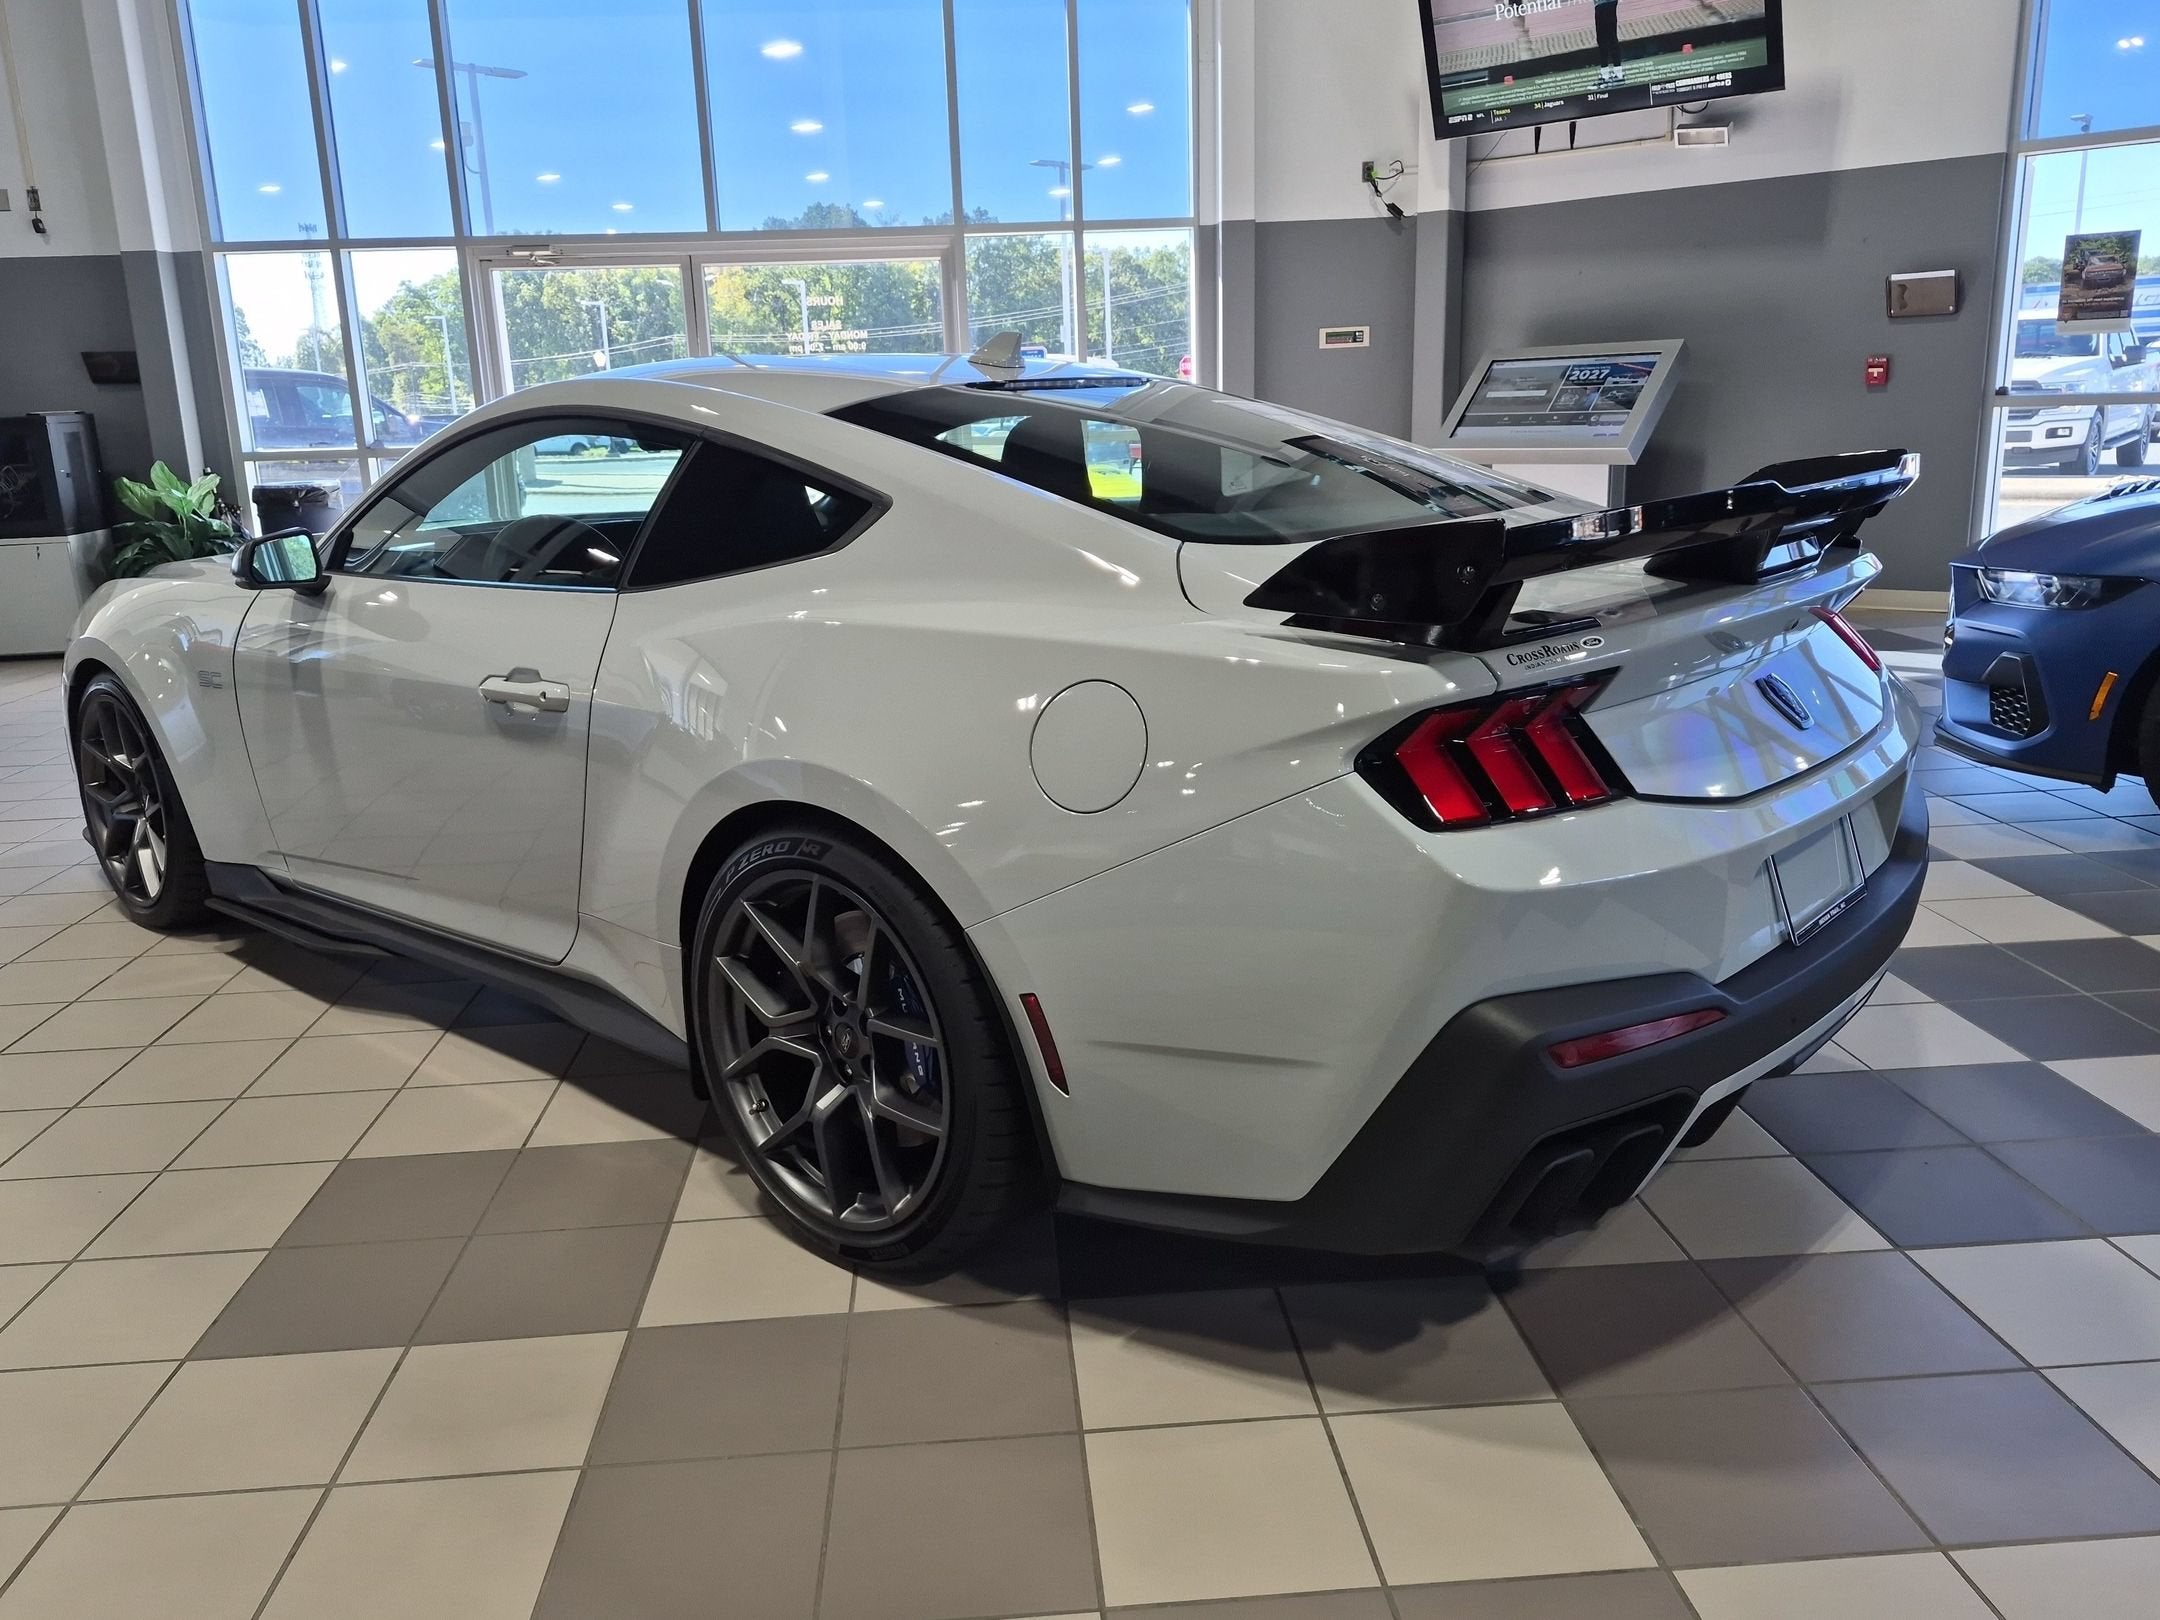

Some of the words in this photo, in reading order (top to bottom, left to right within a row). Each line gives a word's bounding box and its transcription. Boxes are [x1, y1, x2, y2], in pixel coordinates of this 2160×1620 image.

[1495, 0, 1562, 20] Potential
[1543, 100, 1564, 110] Jaguars
[1569, 369, 1610, 380] 2027
[738, 841, 791, 870] ZERO
